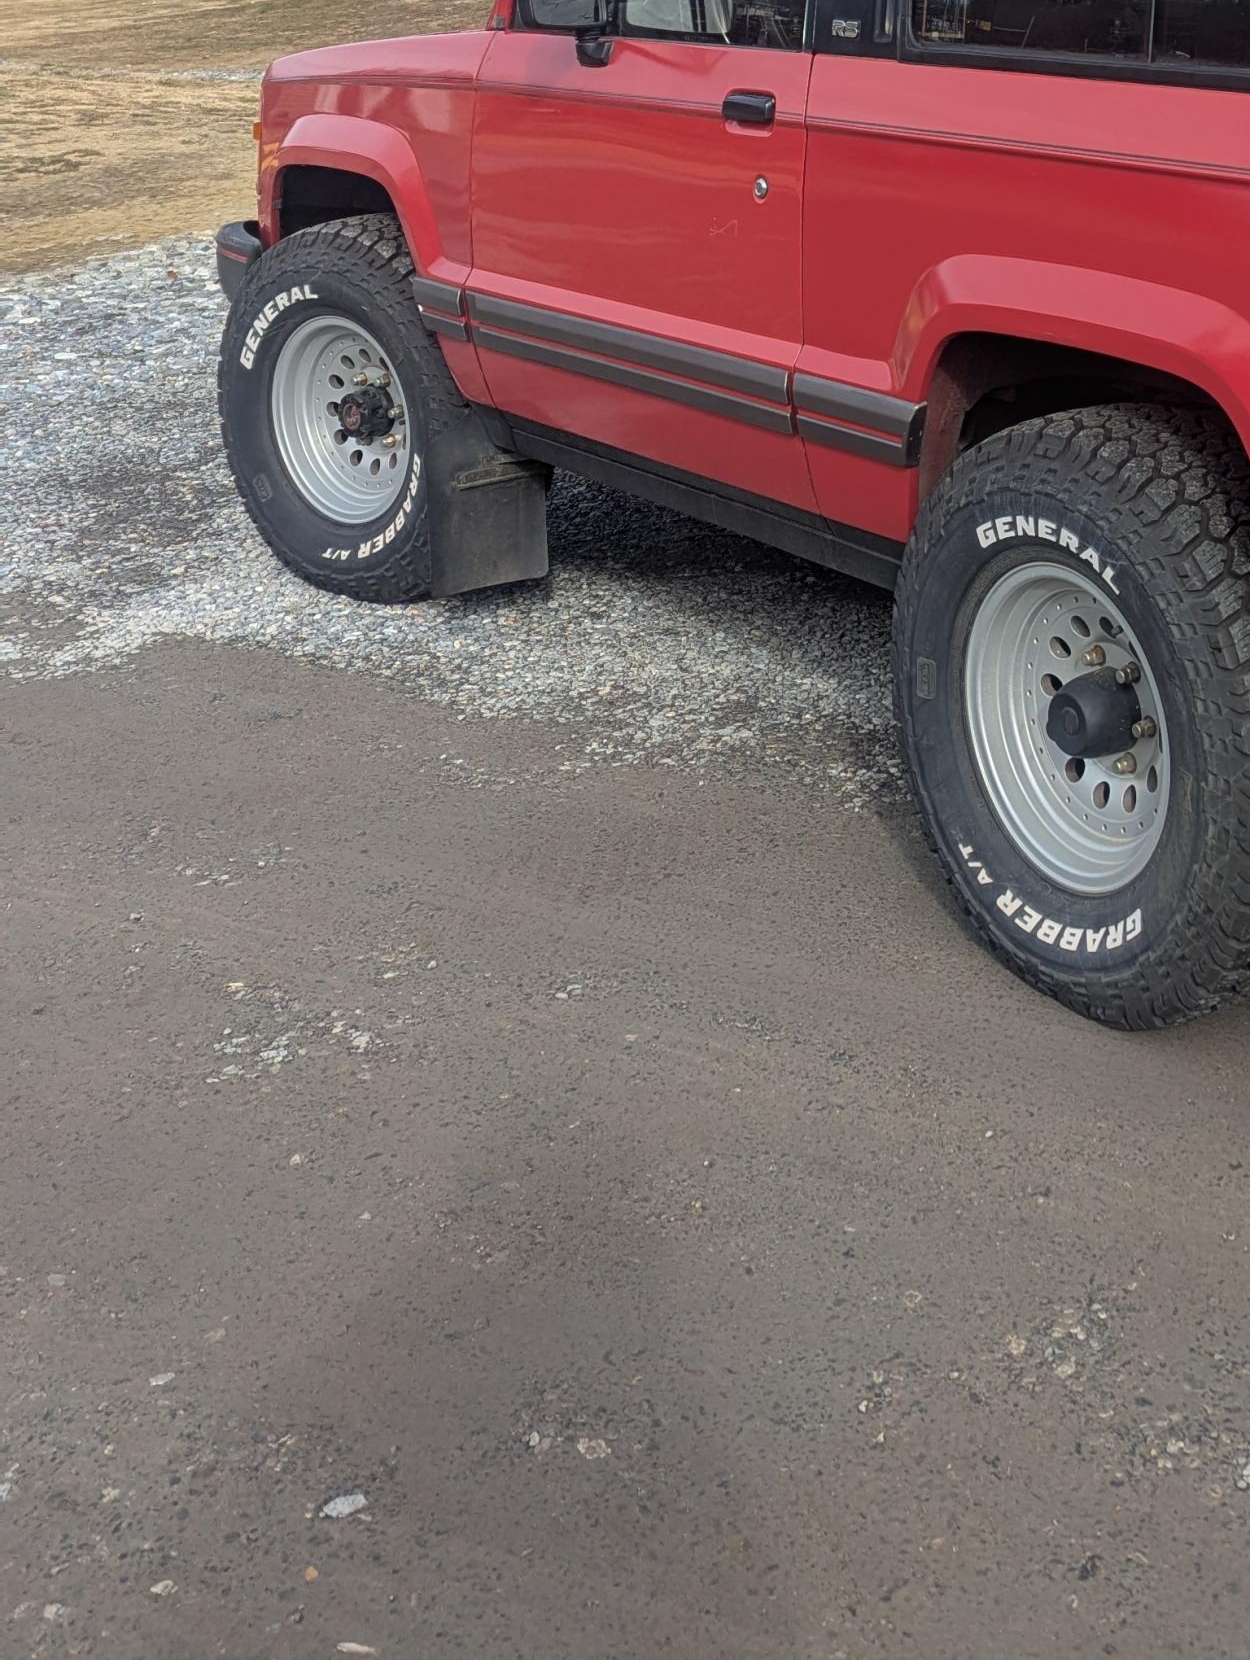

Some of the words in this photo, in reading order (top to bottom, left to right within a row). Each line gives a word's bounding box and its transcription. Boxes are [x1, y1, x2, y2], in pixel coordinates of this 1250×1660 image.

[832, 19, 858, 38] RS
[239, 283, 319, 370] GENERAL
[357, 452, 421, 559] GRABBER
[321, 546, 352, 561] A/T
[975, 515, 1121, 596] GENERAL
[956, 841, 995, 886] A/T
[995, 888, 1143, 954] GRABBER
